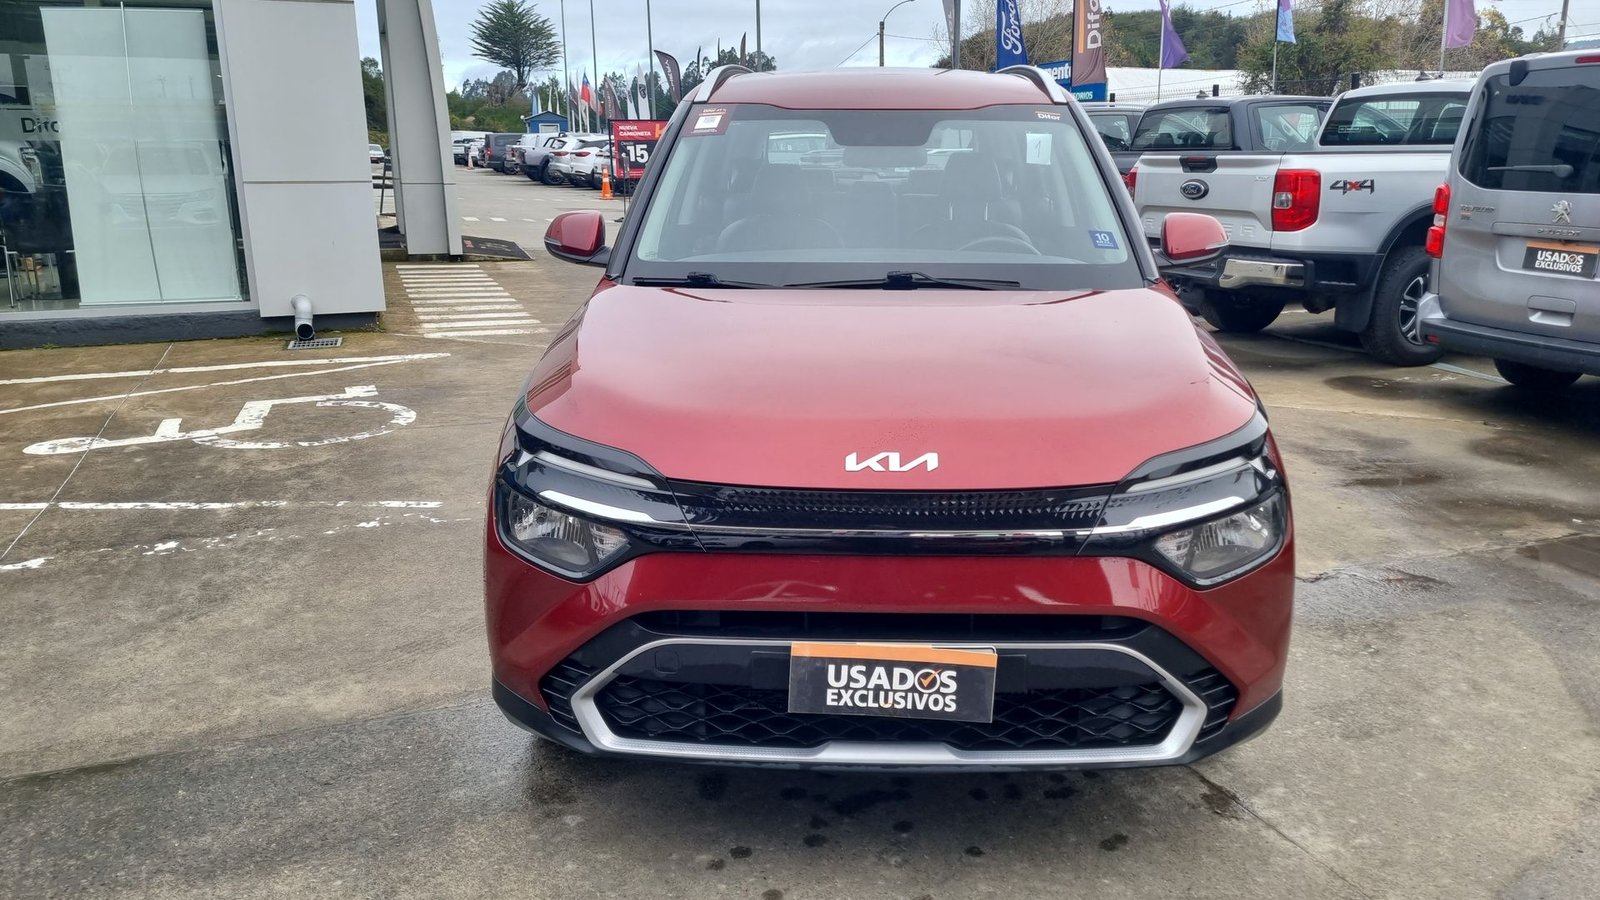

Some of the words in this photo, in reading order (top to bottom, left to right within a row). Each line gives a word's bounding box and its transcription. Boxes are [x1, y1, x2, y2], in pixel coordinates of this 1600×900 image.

[1002, 0, 1022, 55] Ford
[626, 144, 649, 163] 15
[1094, 232, 1110, 242] 10
[1534, 260, 1583, 274] EXCLUSIVOS
[1536, 250, 1585, 266] USADOS
[845, 452, 939, 472] KIA
[827, 664, 957, 694] USADOS
[826, 689, 957, 712] EXCLUSIVOS
